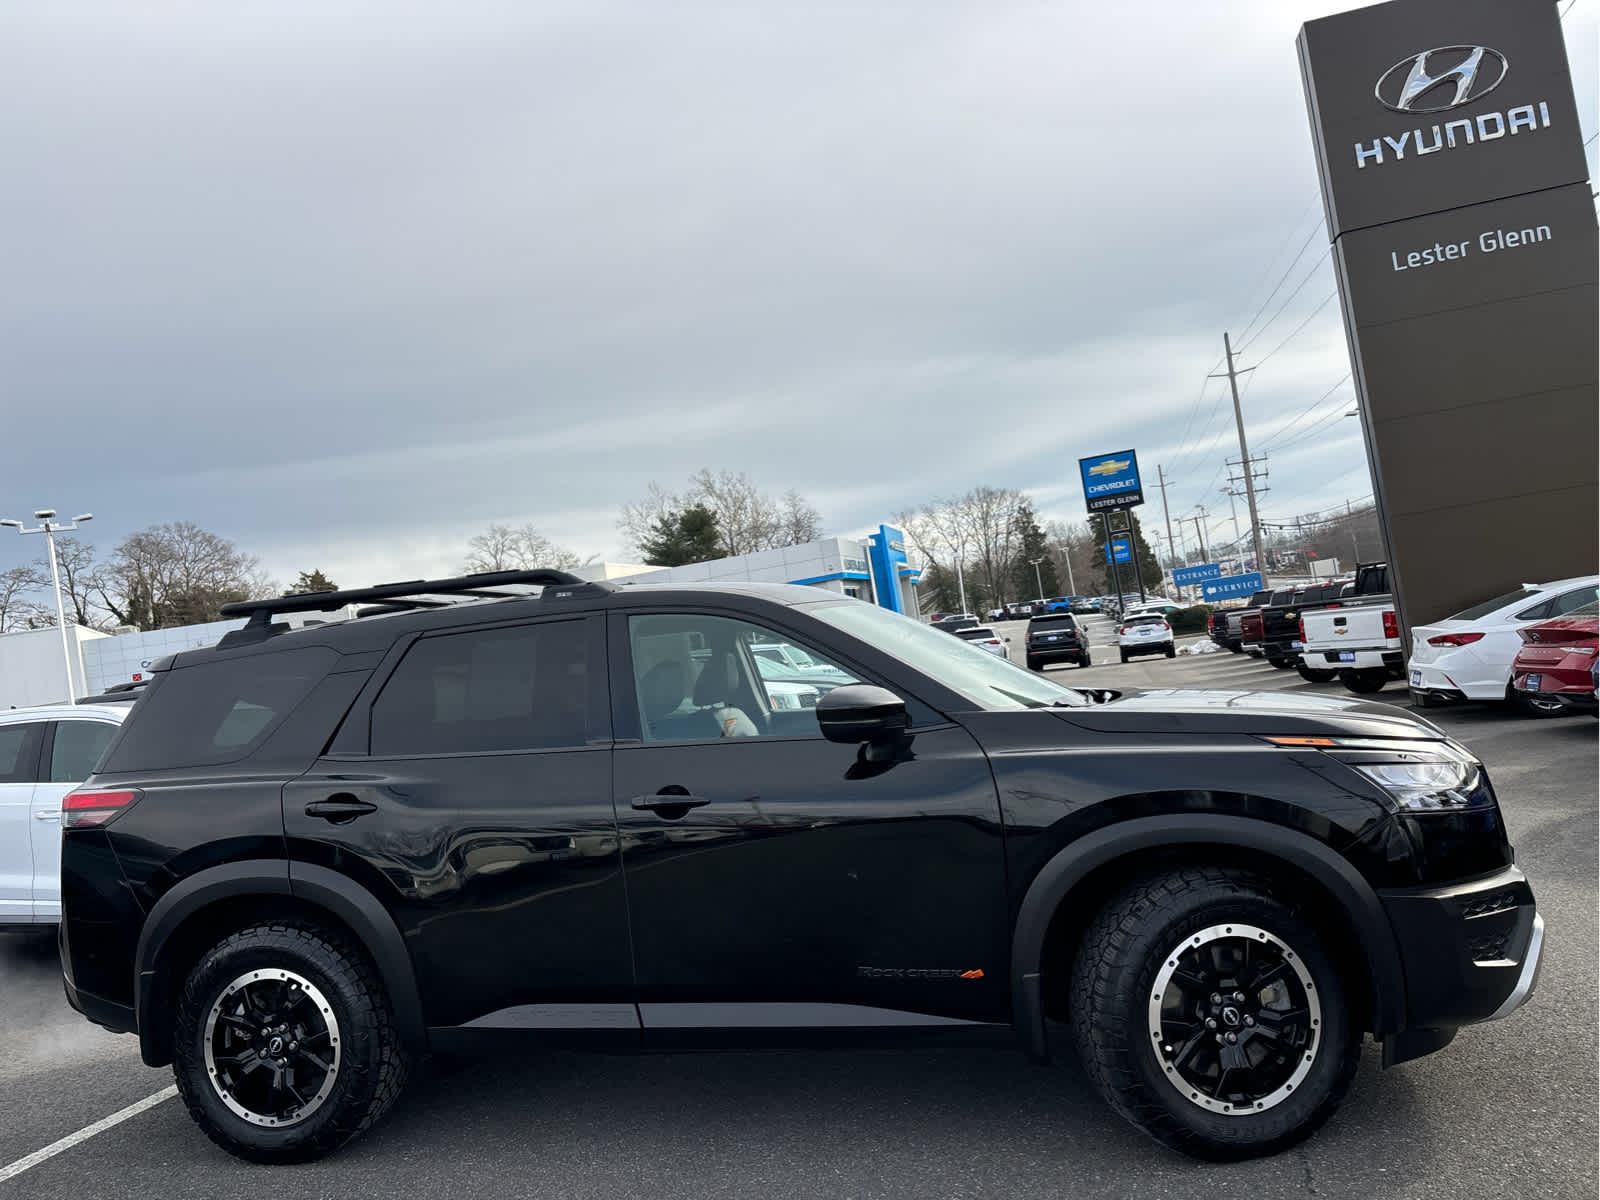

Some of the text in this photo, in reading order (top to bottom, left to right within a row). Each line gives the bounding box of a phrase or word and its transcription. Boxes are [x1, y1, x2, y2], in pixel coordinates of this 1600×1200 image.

[1354, 101, 1551, 169] HYUNDAI
[1391, 225, 1552, 271] Lester Glenn
[1088, 478, 1136, 494] CHEVROLET
[1090, 495, 1139, 509] LESTER GLENN
[1176, 568, 1218, 582] ENTRANCE
[1218, 580, 1260, 593] SERVICE
[857, 966, 961, 978] ROCK CREEK
